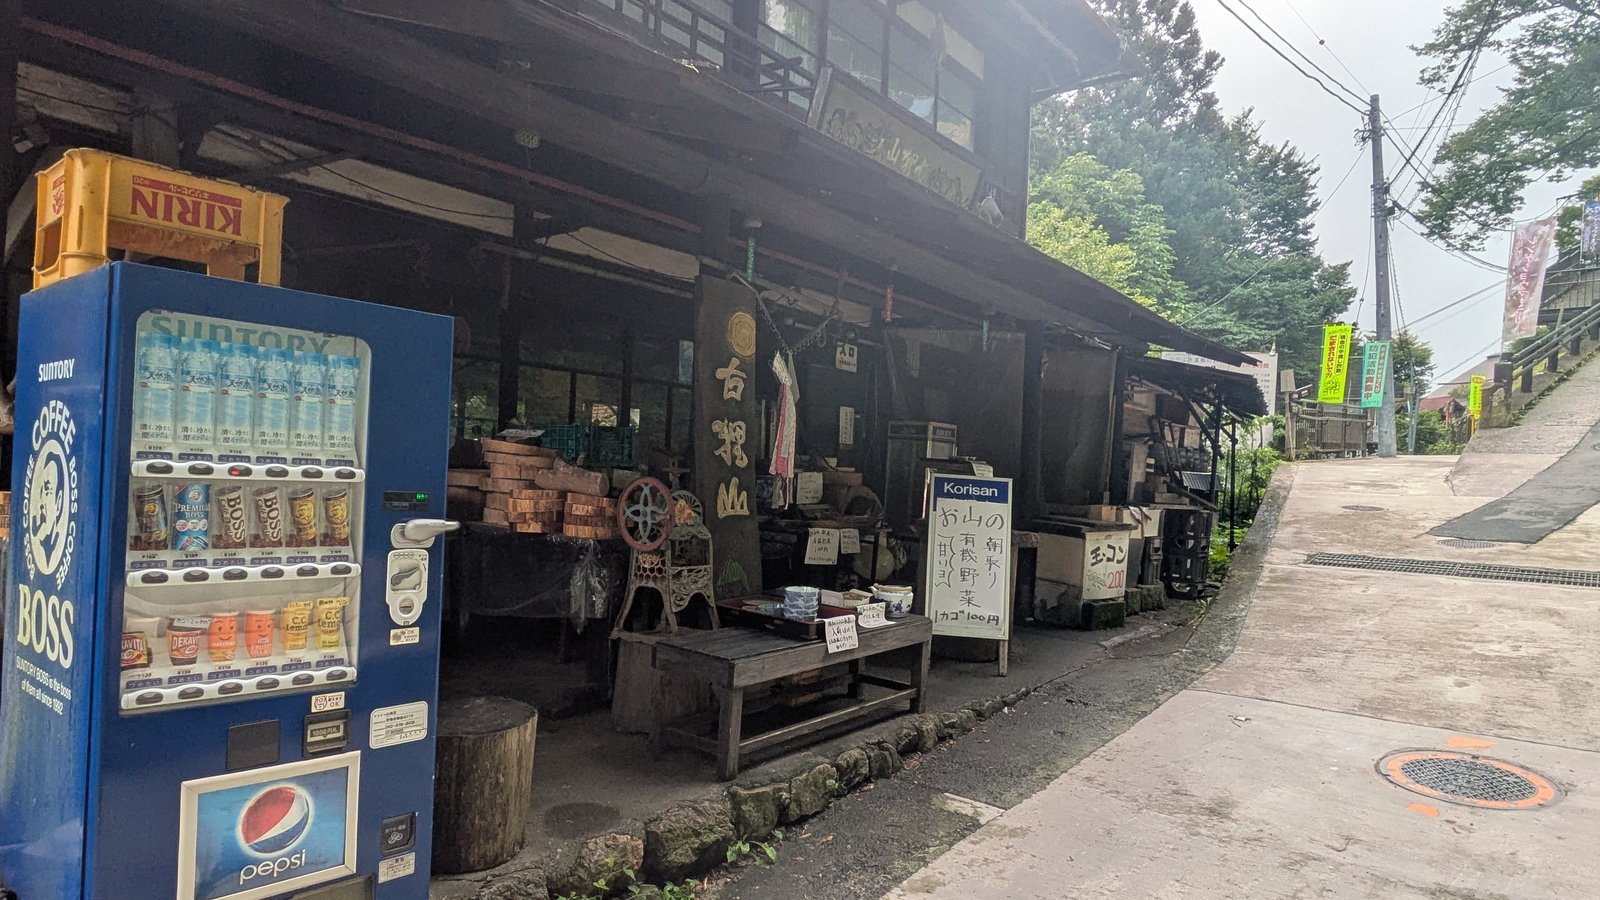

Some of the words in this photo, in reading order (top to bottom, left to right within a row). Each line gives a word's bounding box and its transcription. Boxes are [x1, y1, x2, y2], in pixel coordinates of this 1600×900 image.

[130, 186, 243, 236] KIRIN
[168, 184, 210, 199] キリンビール
[151, 316, 330, 352] SUNTORY
[38, 358, 75, 382] SUNTORY
[32, 400, 76, 455] COFFEE
[23, 454, 35, 528] COFFEE
[69, 456, 78, 514] BOSS
[944, 482, 998, 497] Korisan
[185, 511, 205, 519] BOSS
[227, 495, 246, 540] BOSS
[263, 495, 282, 540] BOSS
[938, 505, 1005, 530] お山の
[56, 521, 76, 591] COFFEE
[959, 532, 982, 608] 有機野菜
[982, 536, 1004, 589] 朝取り
[1107, 570, 1125, 589] 200
[17, 583, 74, 669] BOSS
[285, 624, 308, 633] Lemo
[317, 617, 341, 628] Lemo
[16, 656, 37, 678] SUNTORY
[37, 667, 49, 686] BOSS
[53, 677, 61, 693] the
[60, 681, 72, 700] boss
[22, 678, 27, 690] of
[26, 680, 36, 697] them
[41, 690, 53, 708] since
[52, 698, 64, 715] 1992
[239, 848, 306, 885] pepsi
